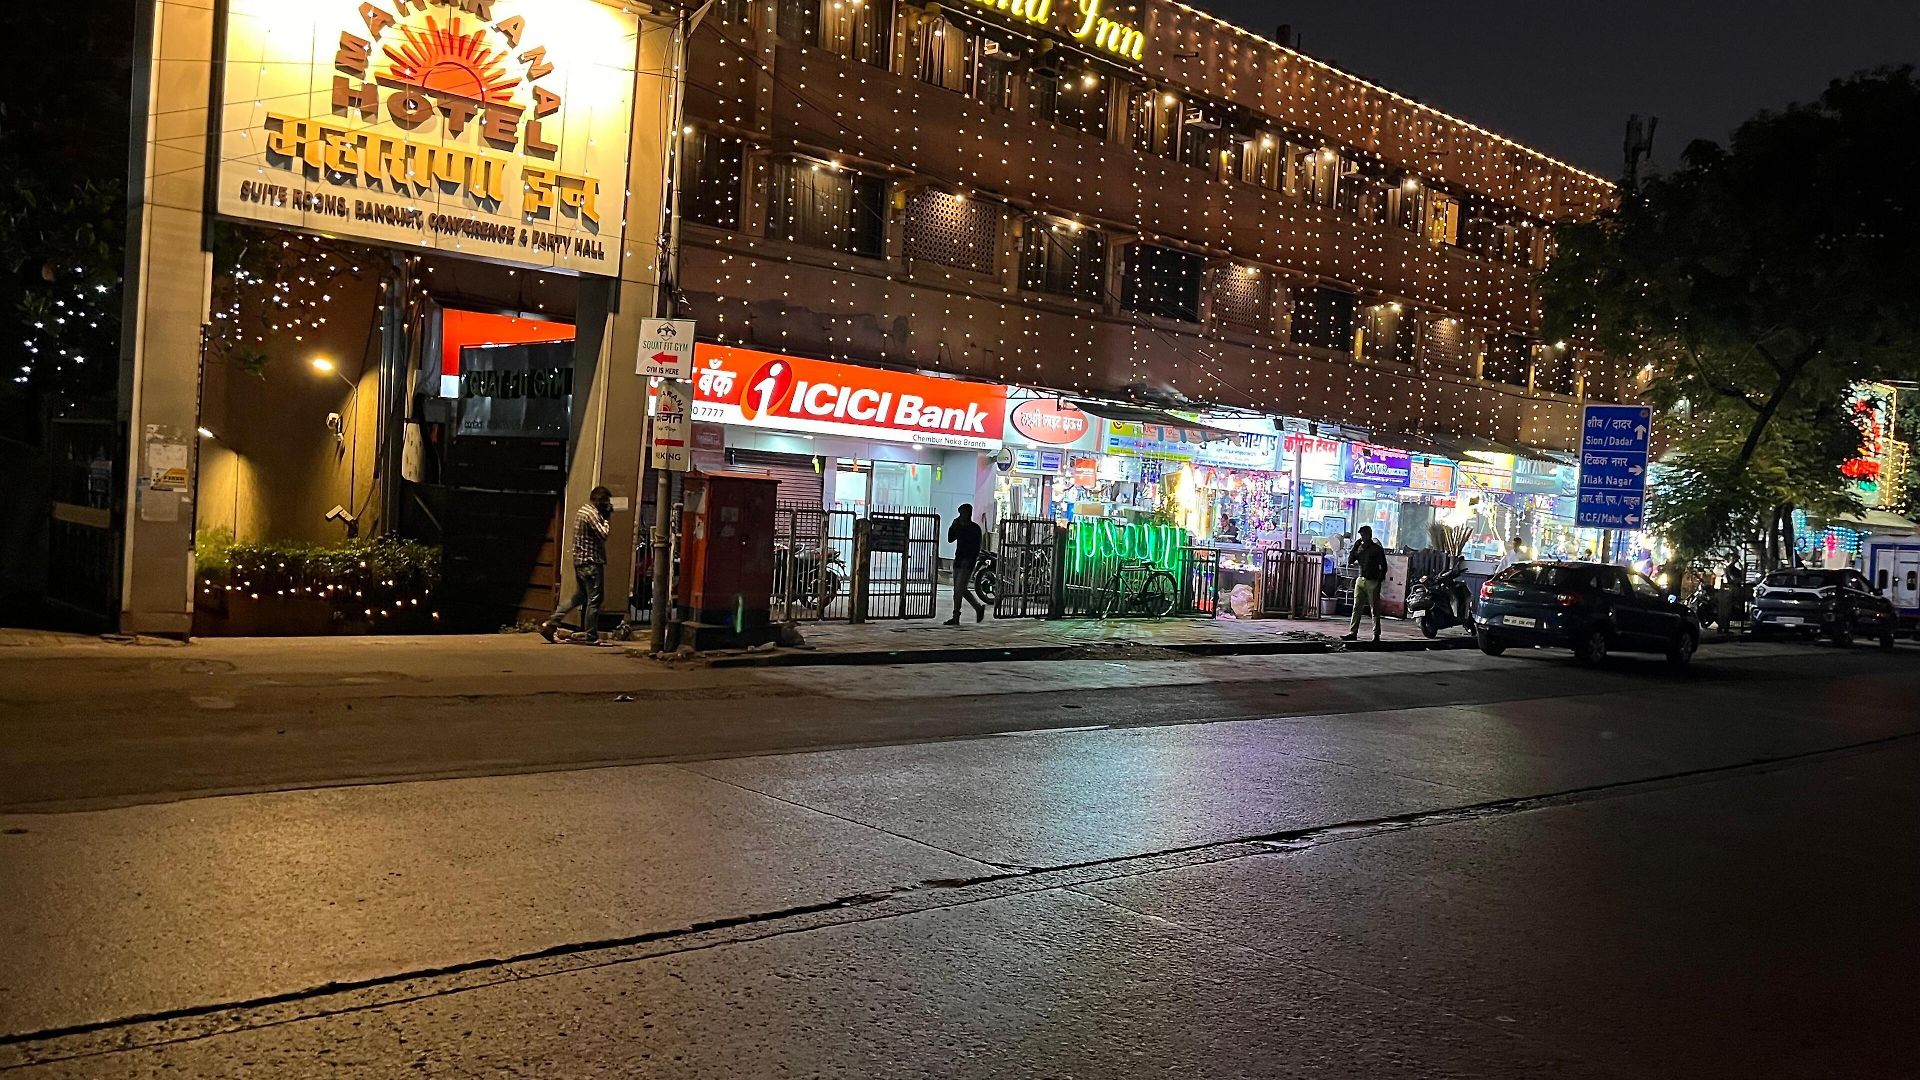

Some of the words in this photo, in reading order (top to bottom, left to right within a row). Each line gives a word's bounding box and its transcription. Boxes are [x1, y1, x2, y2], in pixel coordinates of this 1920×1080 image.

[332, 75, 559, 160] HOTEL
[264, 113, 508, 202] महाराणा
[240, 180, 287, 208] SUITE
[428, 212, 516, 246] CONFERENCE
[518, 228, 528, 248] &
[531, 230, 572, 255] PARTY
[574, 237, 605, 261] HALL
[643, 340, 663, 351] SQUAT
[664, 342, 674, 351] FIT
[674, 342, 689, 352] GYM
[646, 366, 658, 374] GYM
[665, 368, 680, 376] HERE
[701, 407, 725, 418] 7777
[789, 380, 892, 423] ICICI
[893, 394, 989, 434] Bank
[1587, 415, 1604, 428] शीव
[1612, 419, 1633, 430] दादर
[1584, 452, 1608, 466] टिळक
[1611, 457, 1629, 467] नगर
[1582, 474, 1603, 485] Tilak
[1605, 475, 1633, 487] Nagar
